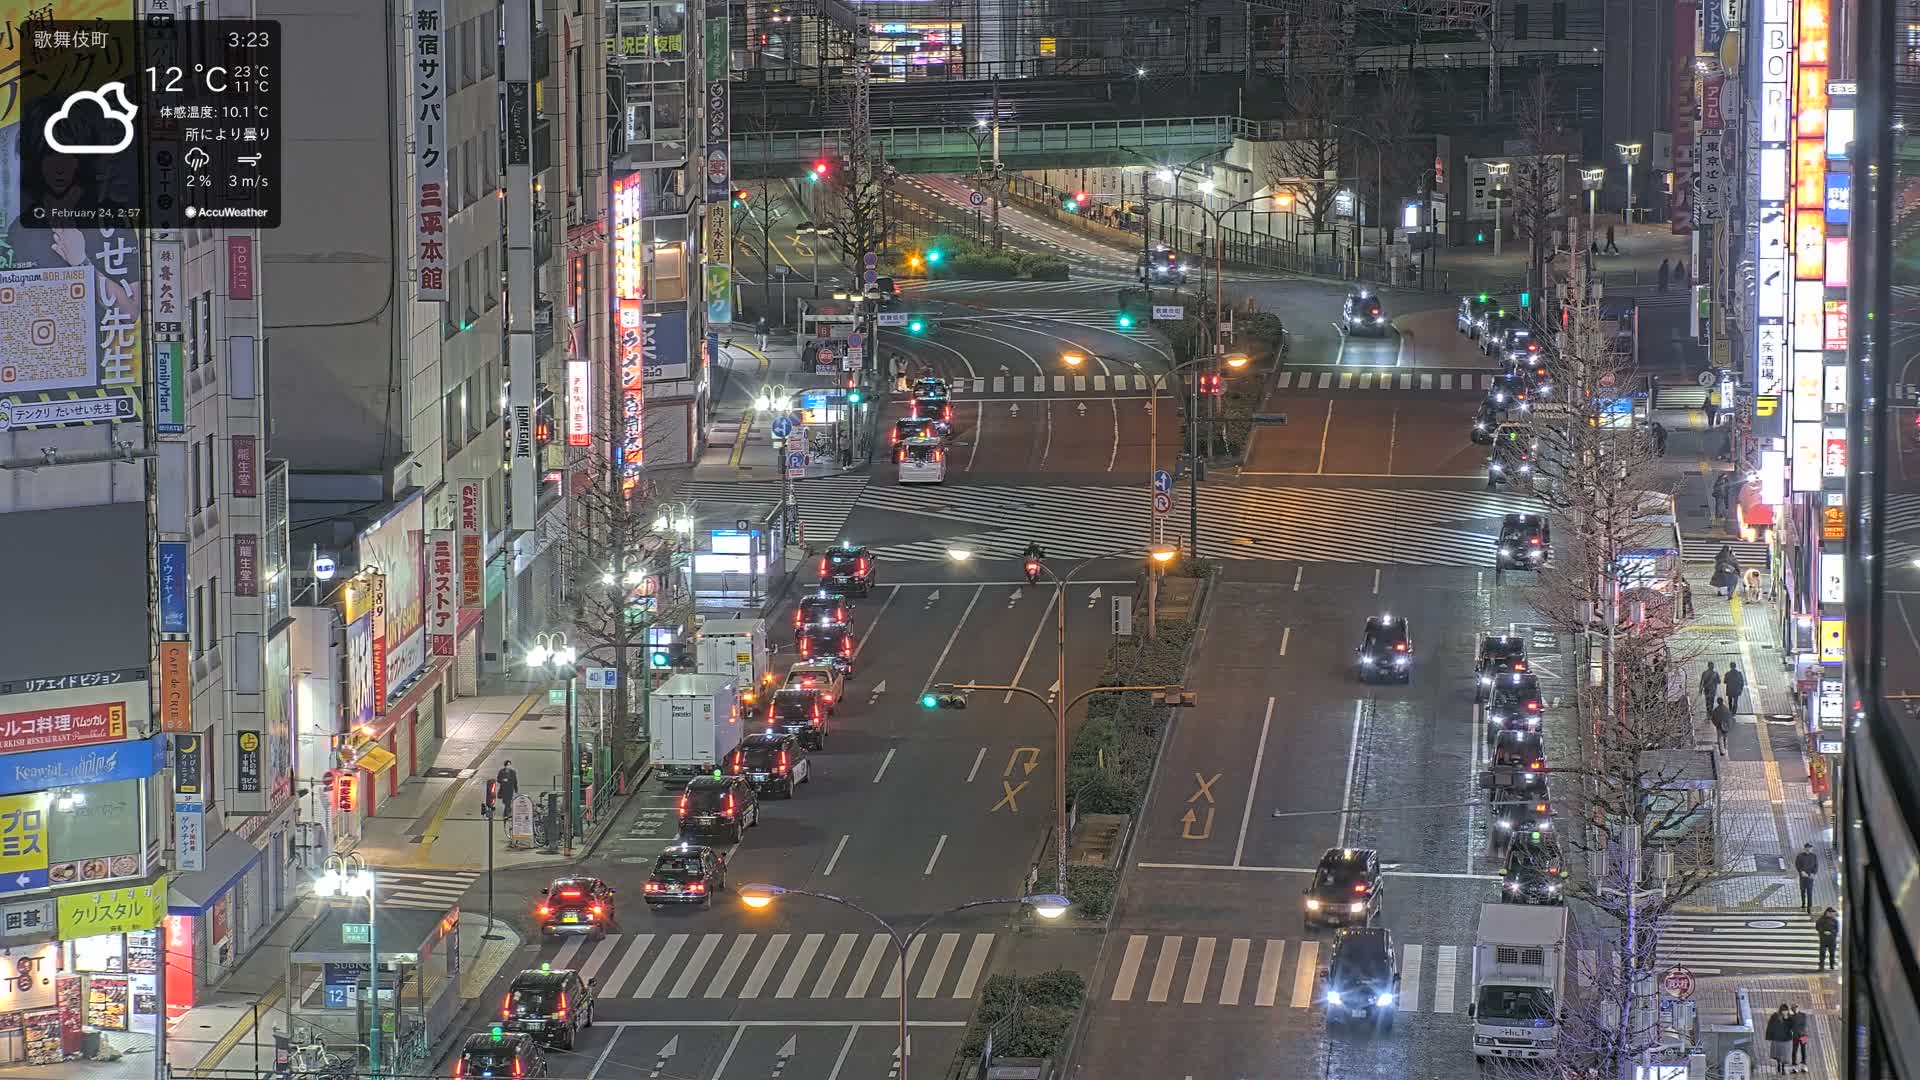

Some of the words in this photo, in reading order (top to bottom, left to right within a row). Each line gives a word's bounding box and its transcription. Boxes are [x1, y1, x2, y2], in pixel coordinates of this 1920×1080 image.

[417, 10, 440, 168] 新宿サンパーク
[420, 183, 443, 290] 三平本館
[160, 323, 177, 332] 3F
[159, 352, 170, 412] FamilyMart
[15, 410, 50, 418] テンクリ
[56, 405, 113, 417] たいせい先生
[517, 406, 530, 458] HOMEGAME
[462, 486, 473, 529] GAME
[163, 554, 174, 604] ゲウチャイ
[435, 541, 451, 628] 三平ストア
[375, 580, 384, 617] 389
[26, 672, 121, 693] リアエイドビジョン
[243, 734, 255, 749] 占
[2, 810, 41, 834] プロ
[2, 835, 41, 856] ミス
[6, 910, 41, 930] 囲碁
[72, 902, 143, 926] クリスタル
[328, 990, 344, 1002] 12
